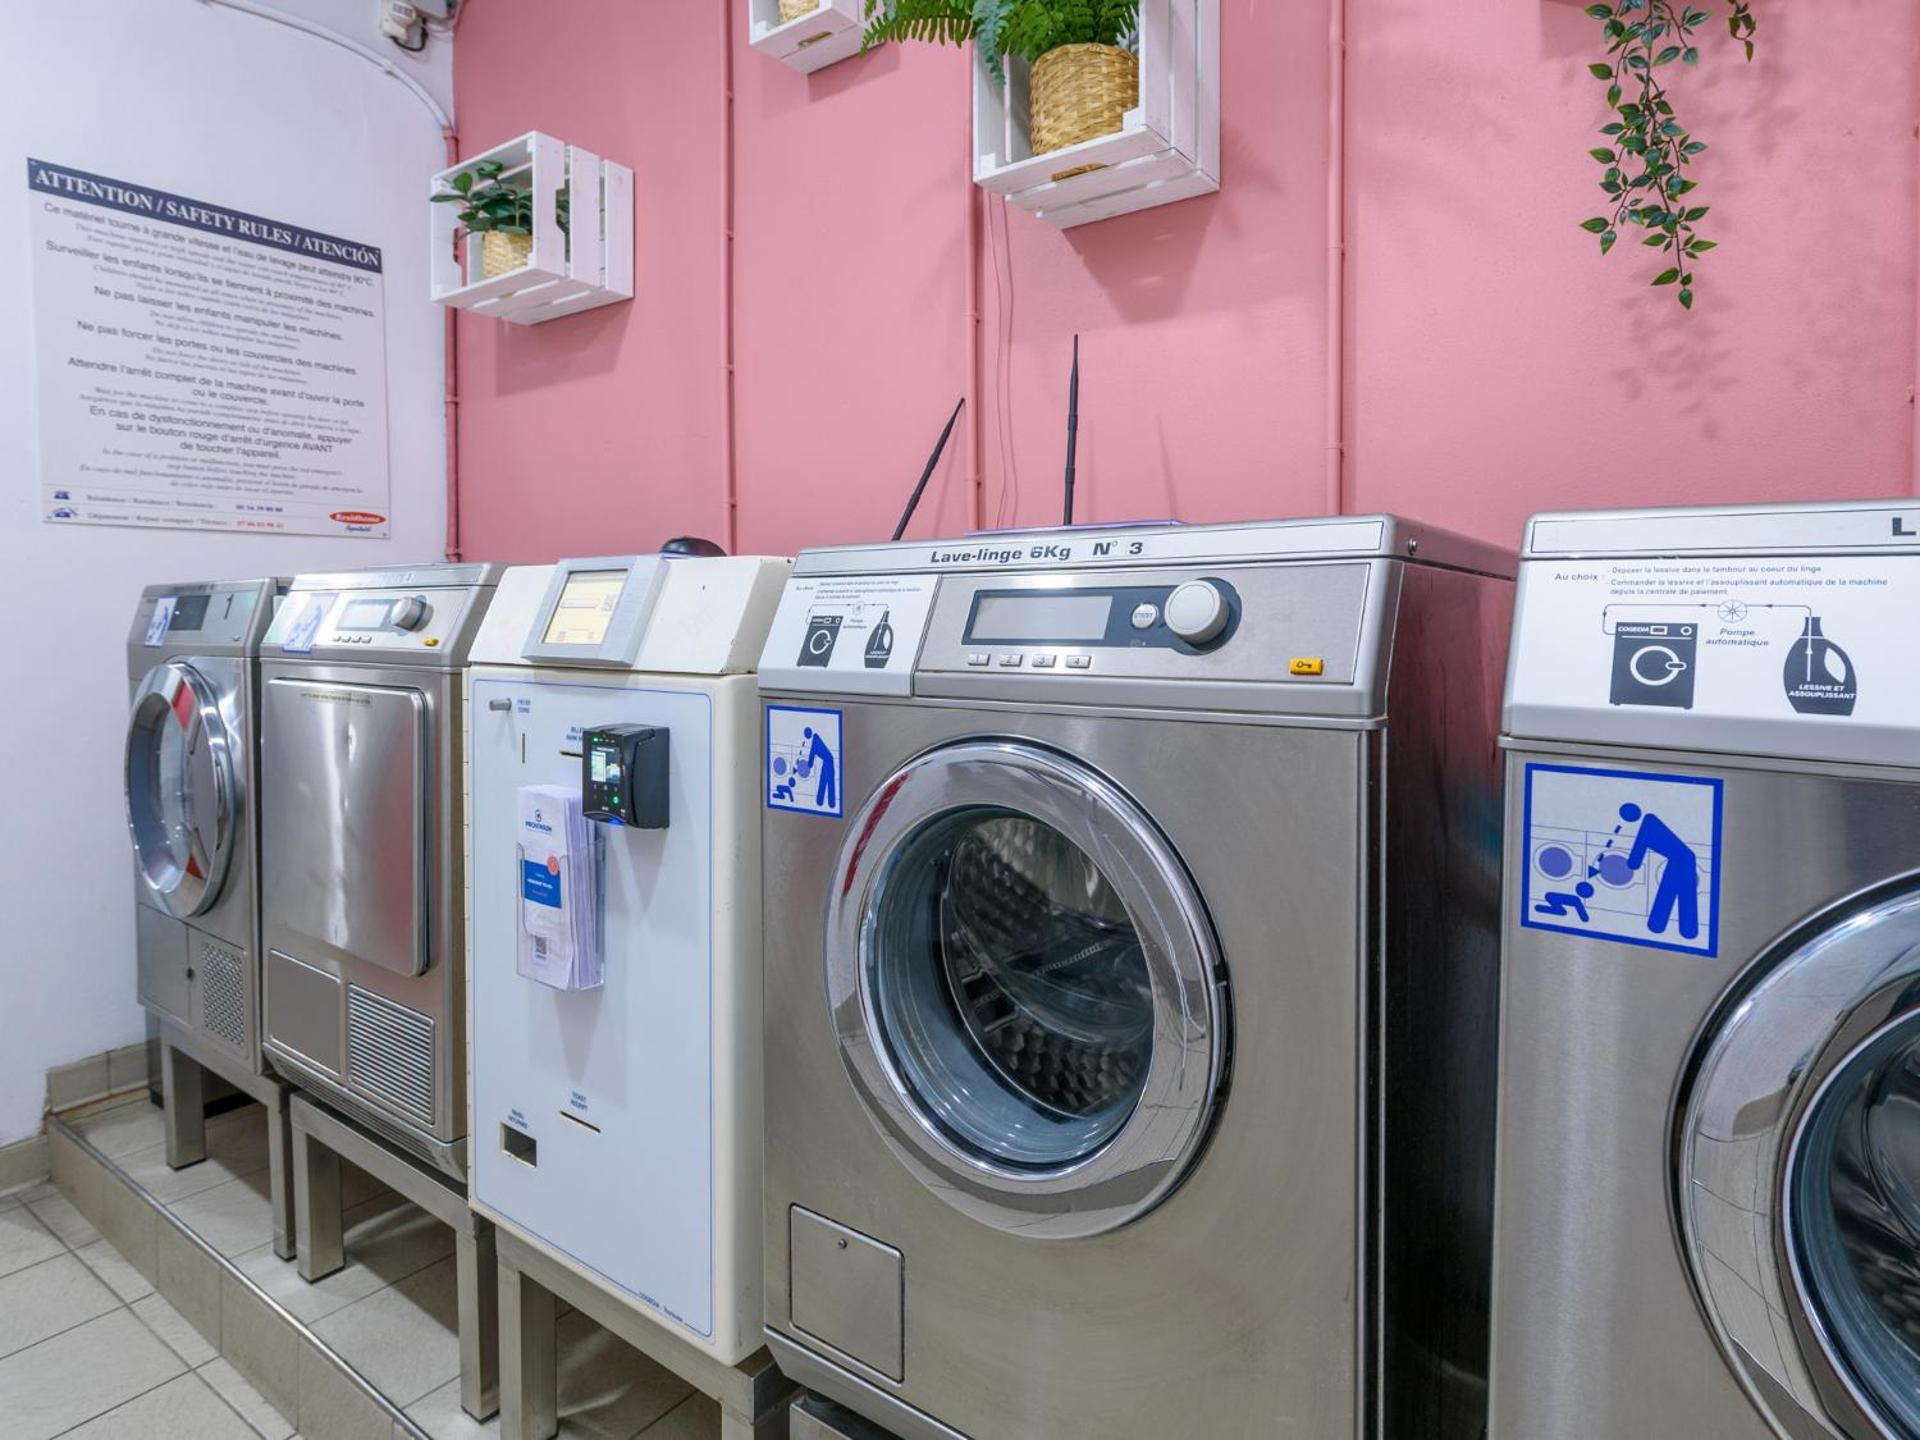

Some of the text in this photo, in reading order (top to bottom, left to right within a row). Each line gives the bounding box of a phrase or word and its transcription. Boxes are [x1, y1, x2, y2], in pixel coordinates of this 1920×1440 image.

[36, 169, 152, 210] ATTENTION
[156, 199, 164, 213] /
[166, 201, 235, 231] SAFETY
[239, 219, 292, 245] RULES
[302, 236, 380, 267] ATENCIÓN
[46, 240, 100, 260] Surveiller
[104, 254, 119, 265] les
[121, 258, 162, 274] enfants
[316, 299, 332, 310] des
[94, 286, 111, 297] Ne
[114, 291, 135, 304] pas
[176, 301, 191, 313] les
[194, 305, 231, 320] enfants
[233, 313, 281, 331] manipuler
[283, 321, 297, 333] les
[77, 320, 95, 332] Ne
[97, 325, 119, 337] pas
[156, 334, 172, 346] les
[174, 338, 208, 352] portes
[210, 344, 223, 354] ou
[225, 345, 240, 357] les
[242, 350, 293, 366] couvercles
[295, 357, 312, 368] des
[67, 356, 117, 373] Attendre
[154, 370, 196, 386] complet
[198, 376, 212, 387] de
[214, 378, 224, 388] la
[226, 381, 267, 395] machine
[269, 387, 296, 399] avant
[343, 398, 365, 410] porte
[192, 389, 205, 399] ou
[208, 390, 217, 400] le
[89, 405, 106, 417] En
[108, 409, 129, 420] cas
[131, 411, 146, 422] de
[247, 425, 261, 435] ou
[317, 434, 353, 447] appuyer
[115, 423, 133, 433] sur
[137, 424, 147, 433] le
[149, 426, 186, 438] bouton
[189, 432, 219, 444] rouge
[254, 438, 301, 452] d'urgence
[302, 442, 333, 454] AVANT
[180, 441, 193, 452] de
[195, 442, 234, 456] toucher
[931, 549, 1022, 564] Lave-linge
[1030, 546, 1071, 561] 6Kg
[1129, 542, 1143, 555] 3
[1682, 566, 1701, 574] dans
[1712, 565, 1746, 574] tambour
[1749, 566, 1757, 574] au
[1787, 565, 1798, 573] du
[1801, 565, 1822, 575] linge
[1554, 572, 1599, 582] Au choix
[1611, 578, 1656, 587] Commander
[1770, 578, 1823, 588] automatique
[1825, 578, 1836, 587] de
[1838, 578, 1847, 587] la
[1849, 577, 1888, 587] machine
[1610, 587, 1635, 596] depuis
[1679, 588, 1689, 596] de
[1719, 628, 1756, 637] Pompe
[1705, 638, 1770, 647] automatique
[1798, 683, 1845, 692] LESSIVE ET
[1788, 690, 1857, 699] ASSOUPLISSANT
